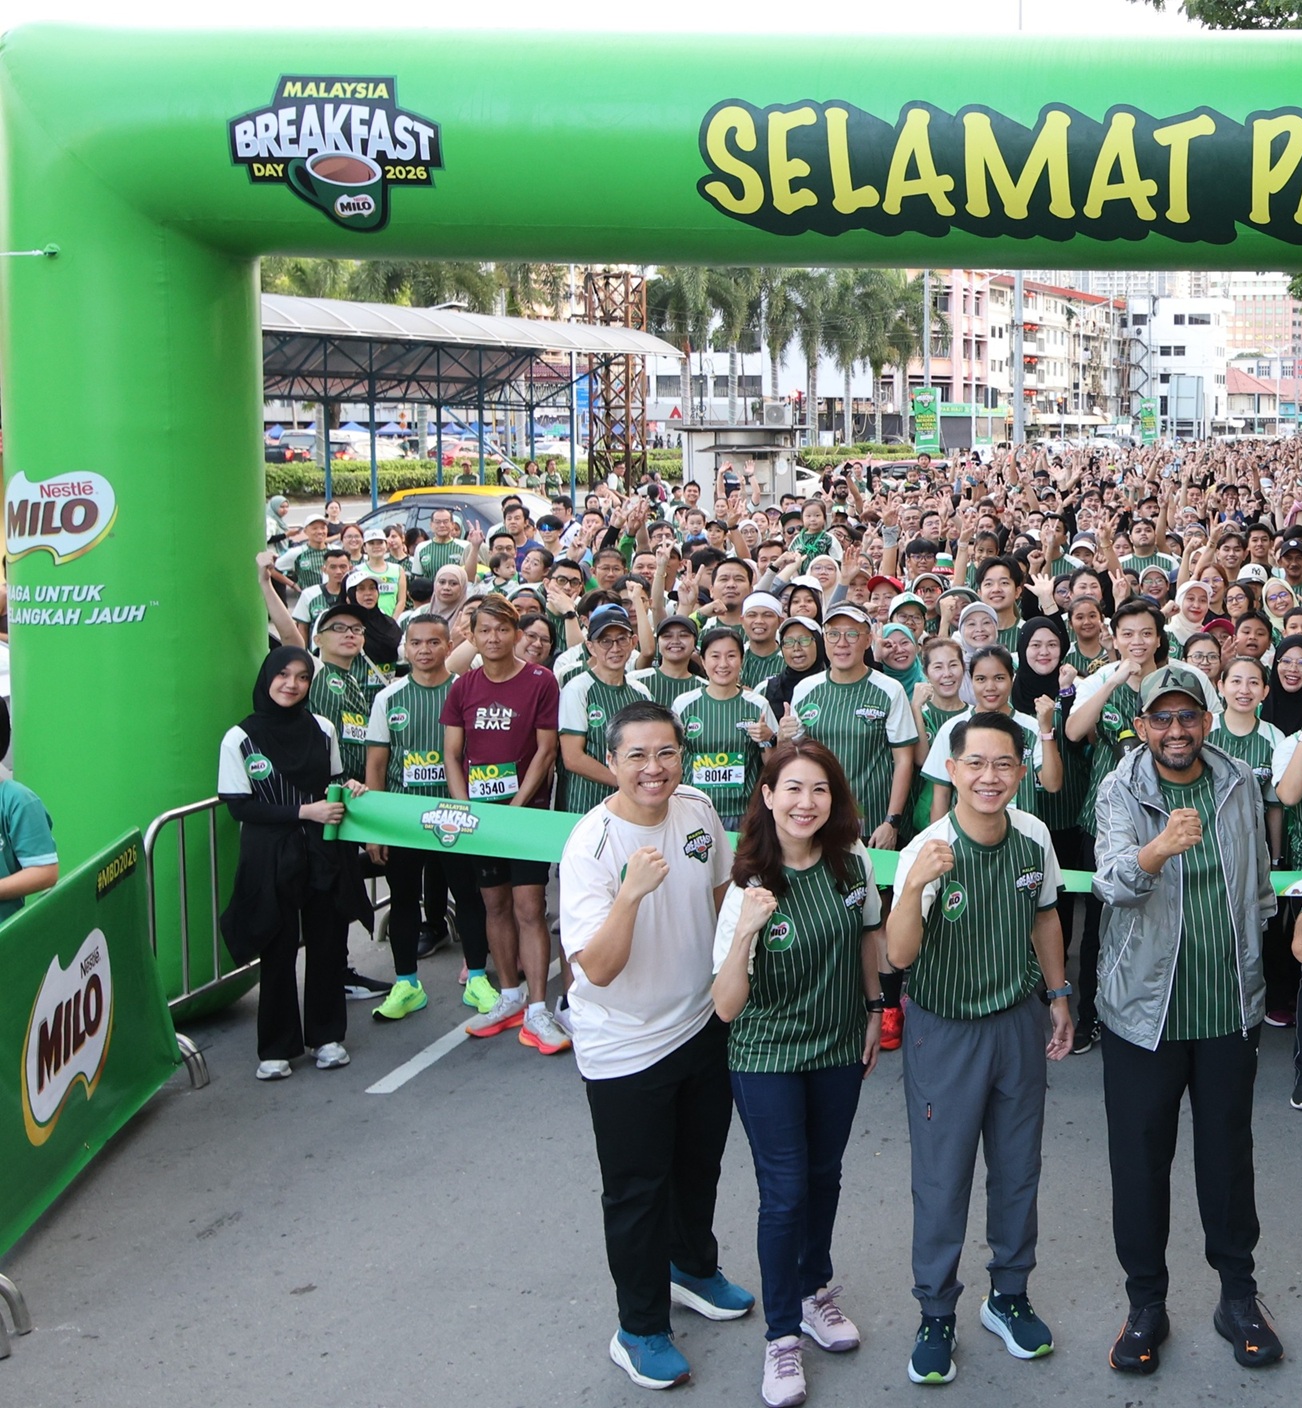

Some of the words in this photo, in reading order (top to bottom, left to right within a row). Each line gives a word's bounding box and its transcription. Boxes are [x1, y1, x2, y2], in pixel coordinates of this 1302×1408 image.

[282, 81, 390, 99] MALAYSIA
[234, 103, 435, 161] BREAKFAST
[252, 163, 285, 177] DAY
[384, 165, 428, 179] 2026
[704, 105, 1216, 224] SELAMAT
[339, 201, 372, 212] MILO
[7, 498, 99, 539] MILO
[34, 585, 105, 602] UNTUK
[84, 605, 146, 625] JAUH
[476, 707, 513, 718] RUN
[474, 720, 511, 731] RMC
[250, 763, 266, 771] MILO
[404, 751, 440, 768] MILO
[693, 752, 729, 771] MILO
[414, 767, 445, 781] 6015A
[468, 765, 499, 785] MILO
[704, 769, 733, 782] 8014F
[479, 781, 505, 796] 3540
[438, 803, 469, 811] MALAYSIA
[421, 809, 479, 828] BREAKFAST
[97, 844, 137, 893] #MBD2026
[37, 973, 104, 1096] MILO
